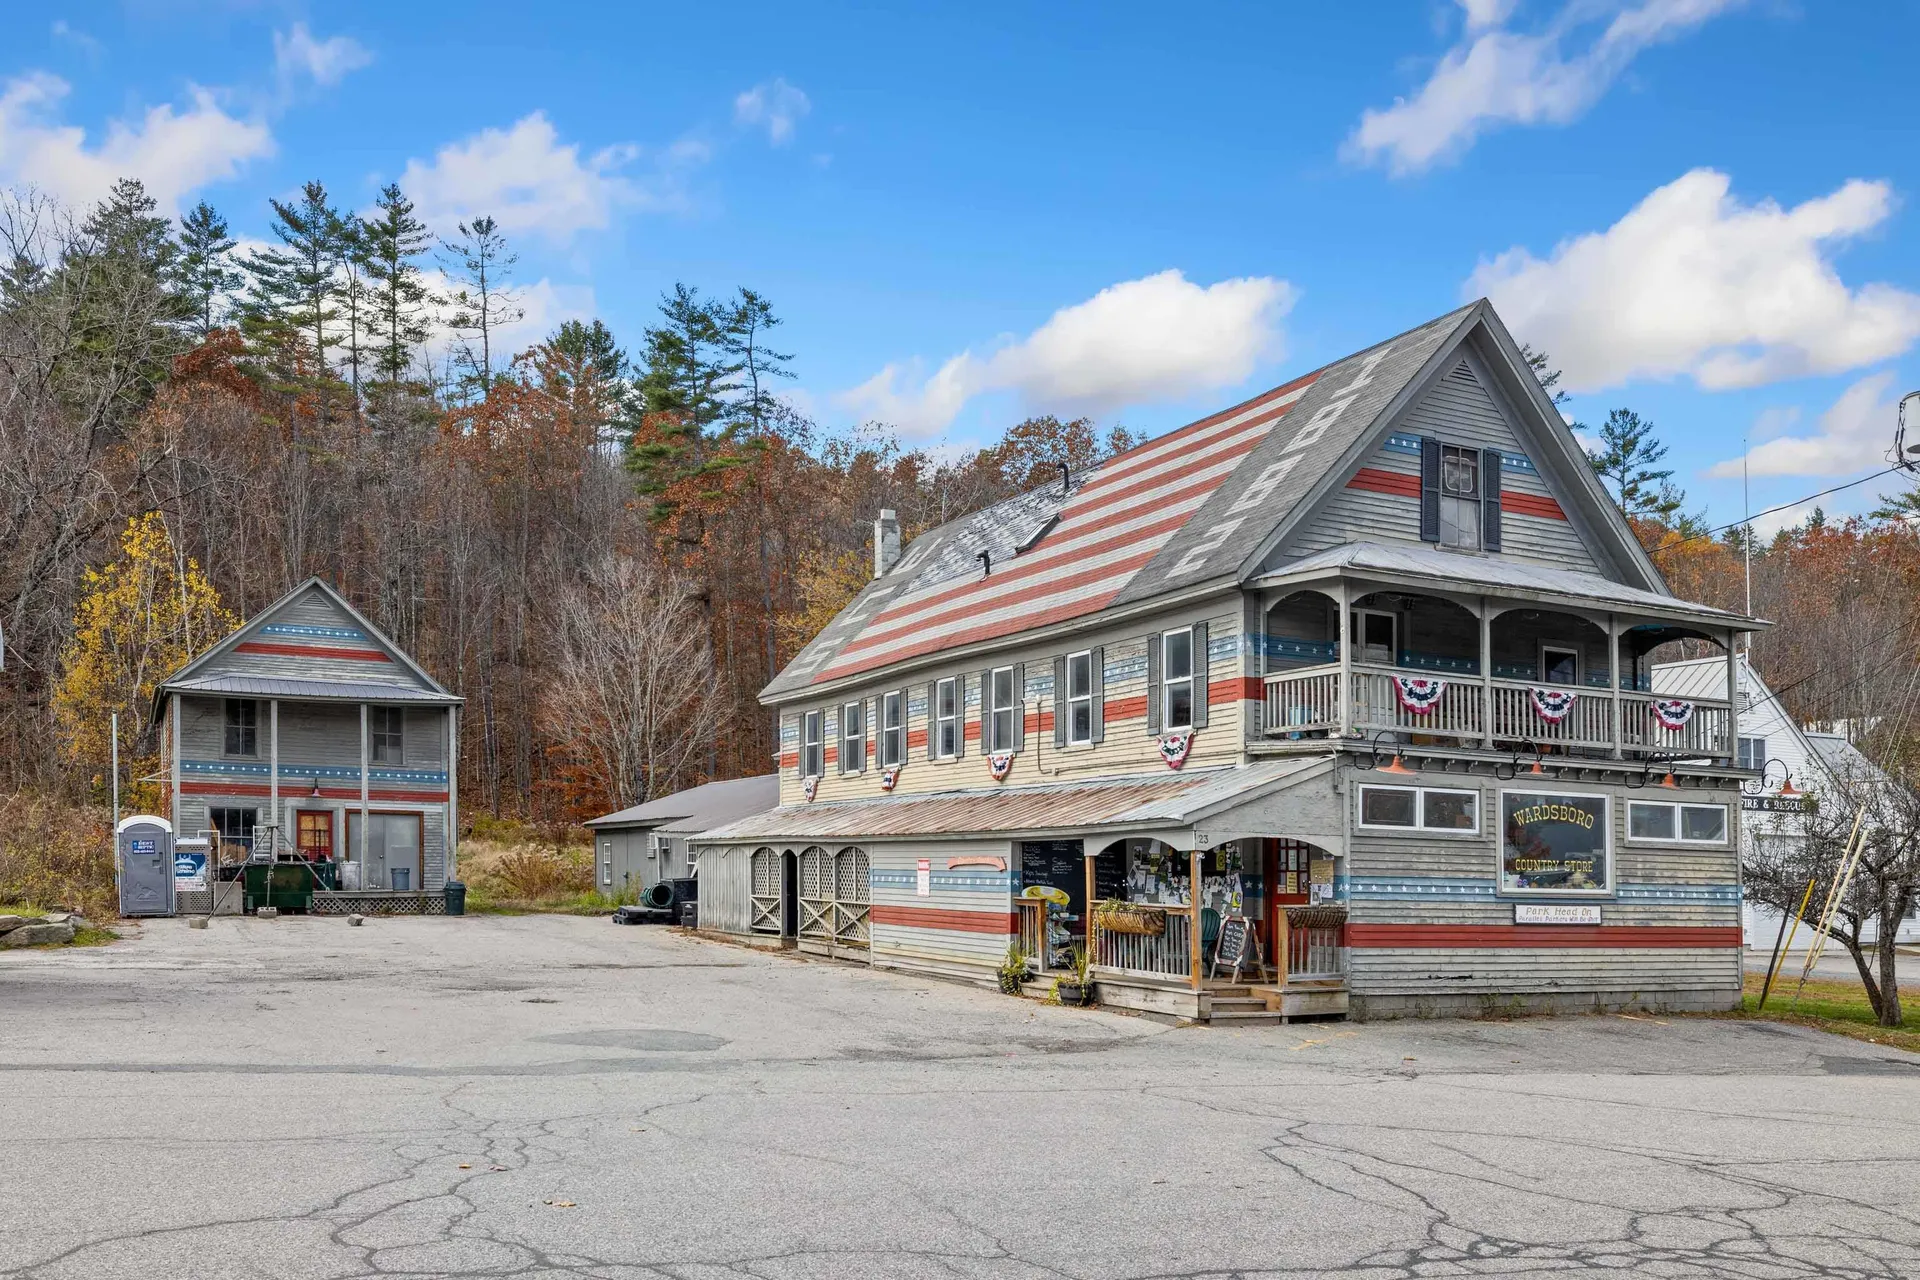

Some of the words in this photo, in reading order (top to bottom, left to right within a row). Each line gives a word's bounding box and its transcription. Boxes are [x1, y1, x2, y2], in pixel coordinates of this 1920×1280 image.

[1513, 804, 1594, 829] WARDSBORO
[1198, 834, 1209, 844] 23
[1515, 859, 1560, 872] COUNTRY
[1564, 860, 1594, 873] STORE
[1554, 907, 1578, 916] Head
